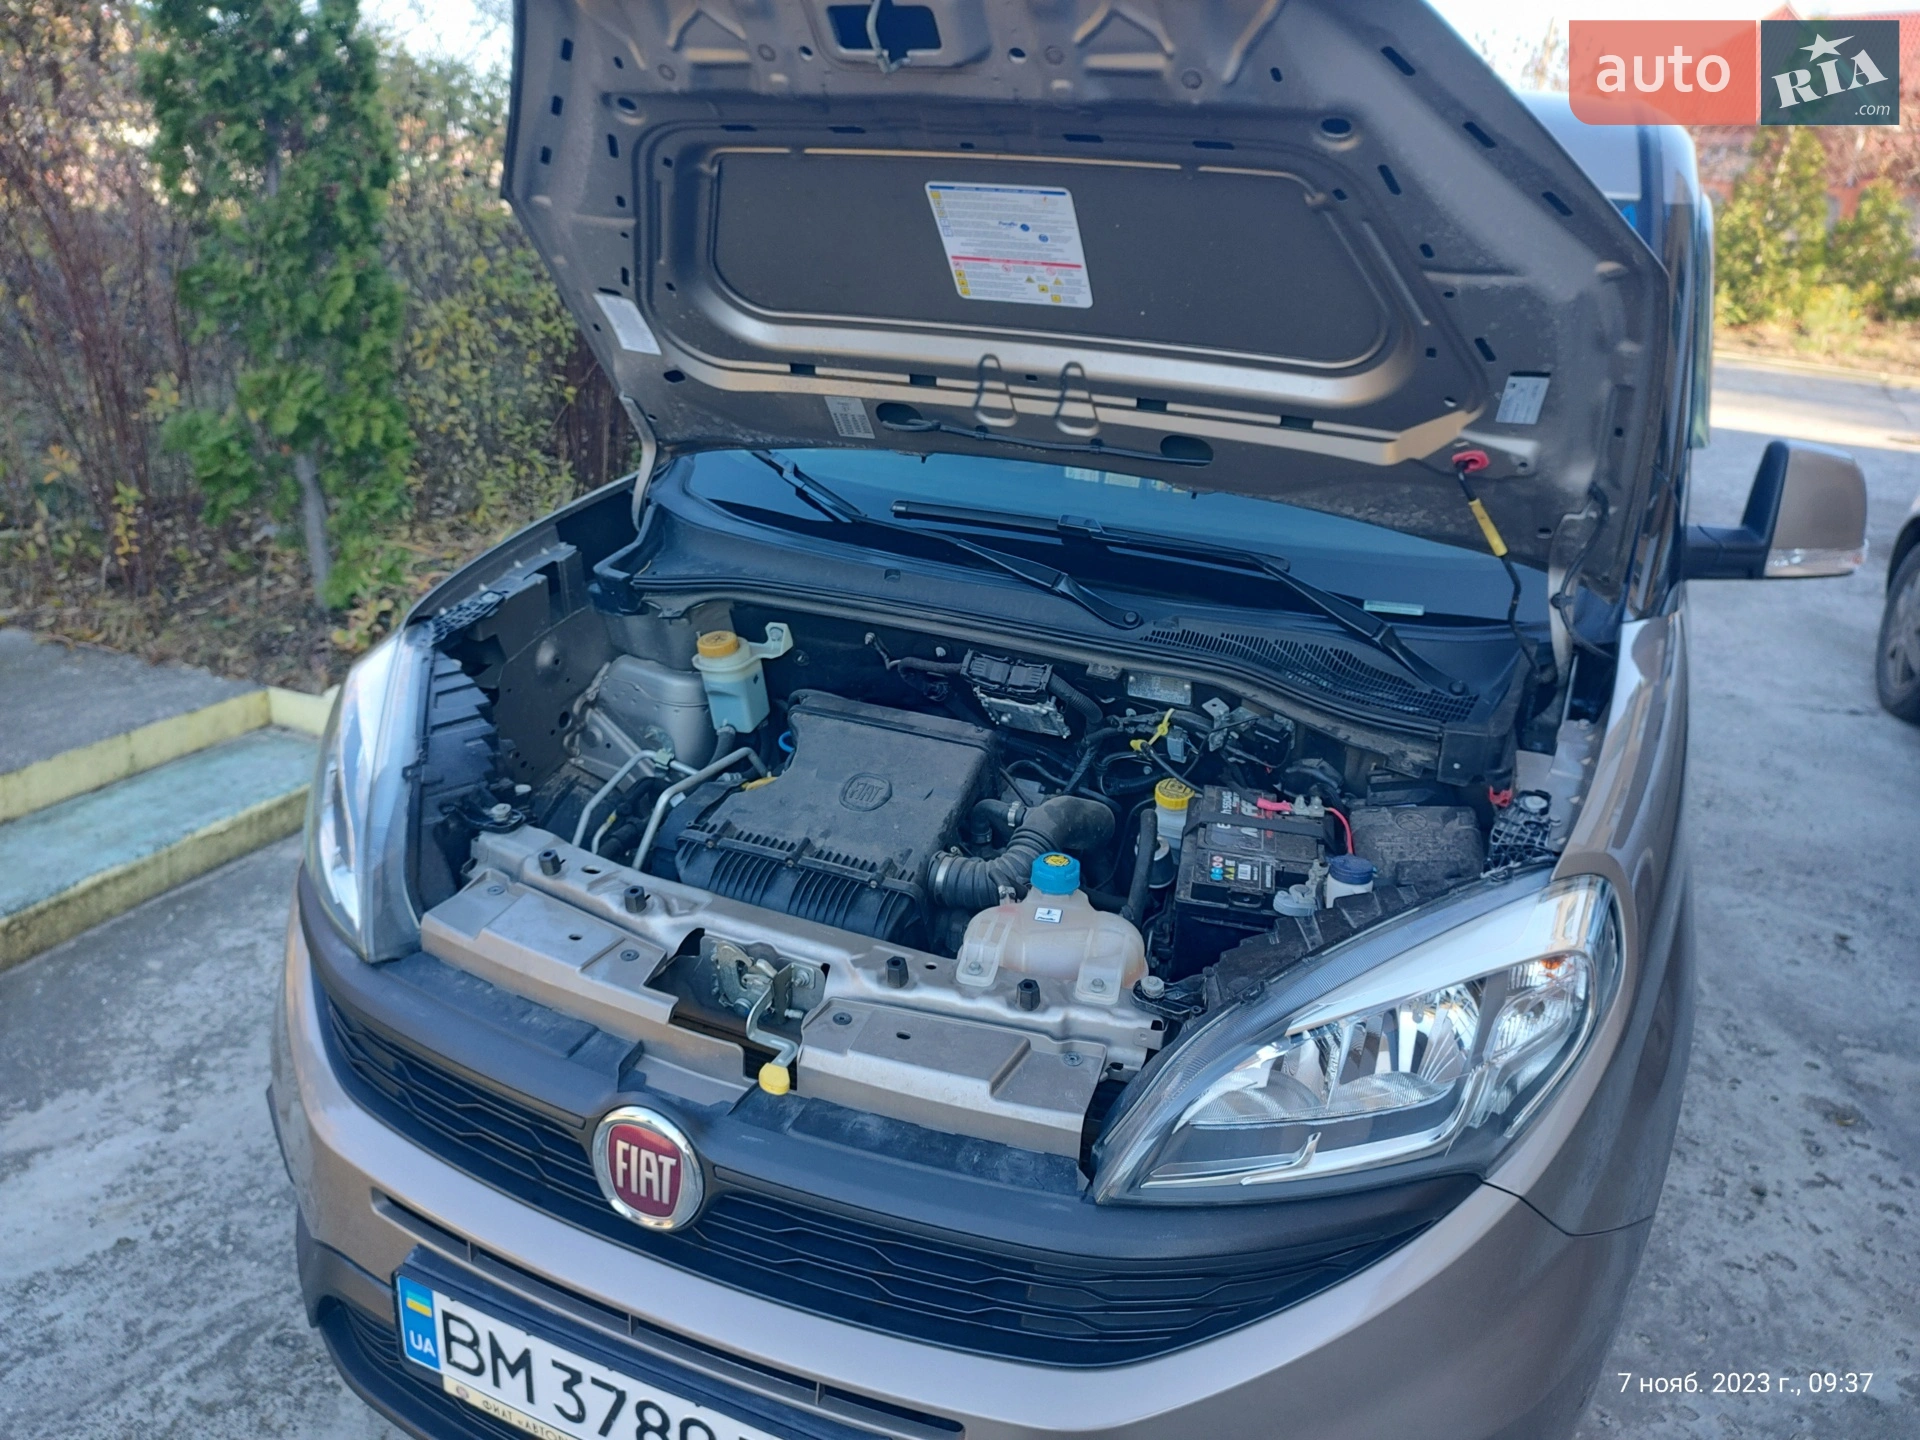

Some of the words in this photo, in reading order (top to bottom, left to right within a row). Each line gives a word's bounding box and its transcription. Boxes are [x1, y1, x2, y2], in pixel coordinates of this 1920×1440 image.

[849, 781, 884, 803] FIAT
[616, 1139, 677, 1205] FIAT
[409, 1330, 436, 1358] UA
[441, 1310, 535, 1405] BM
[482, 1400, 513, 1421] ФИАТ
